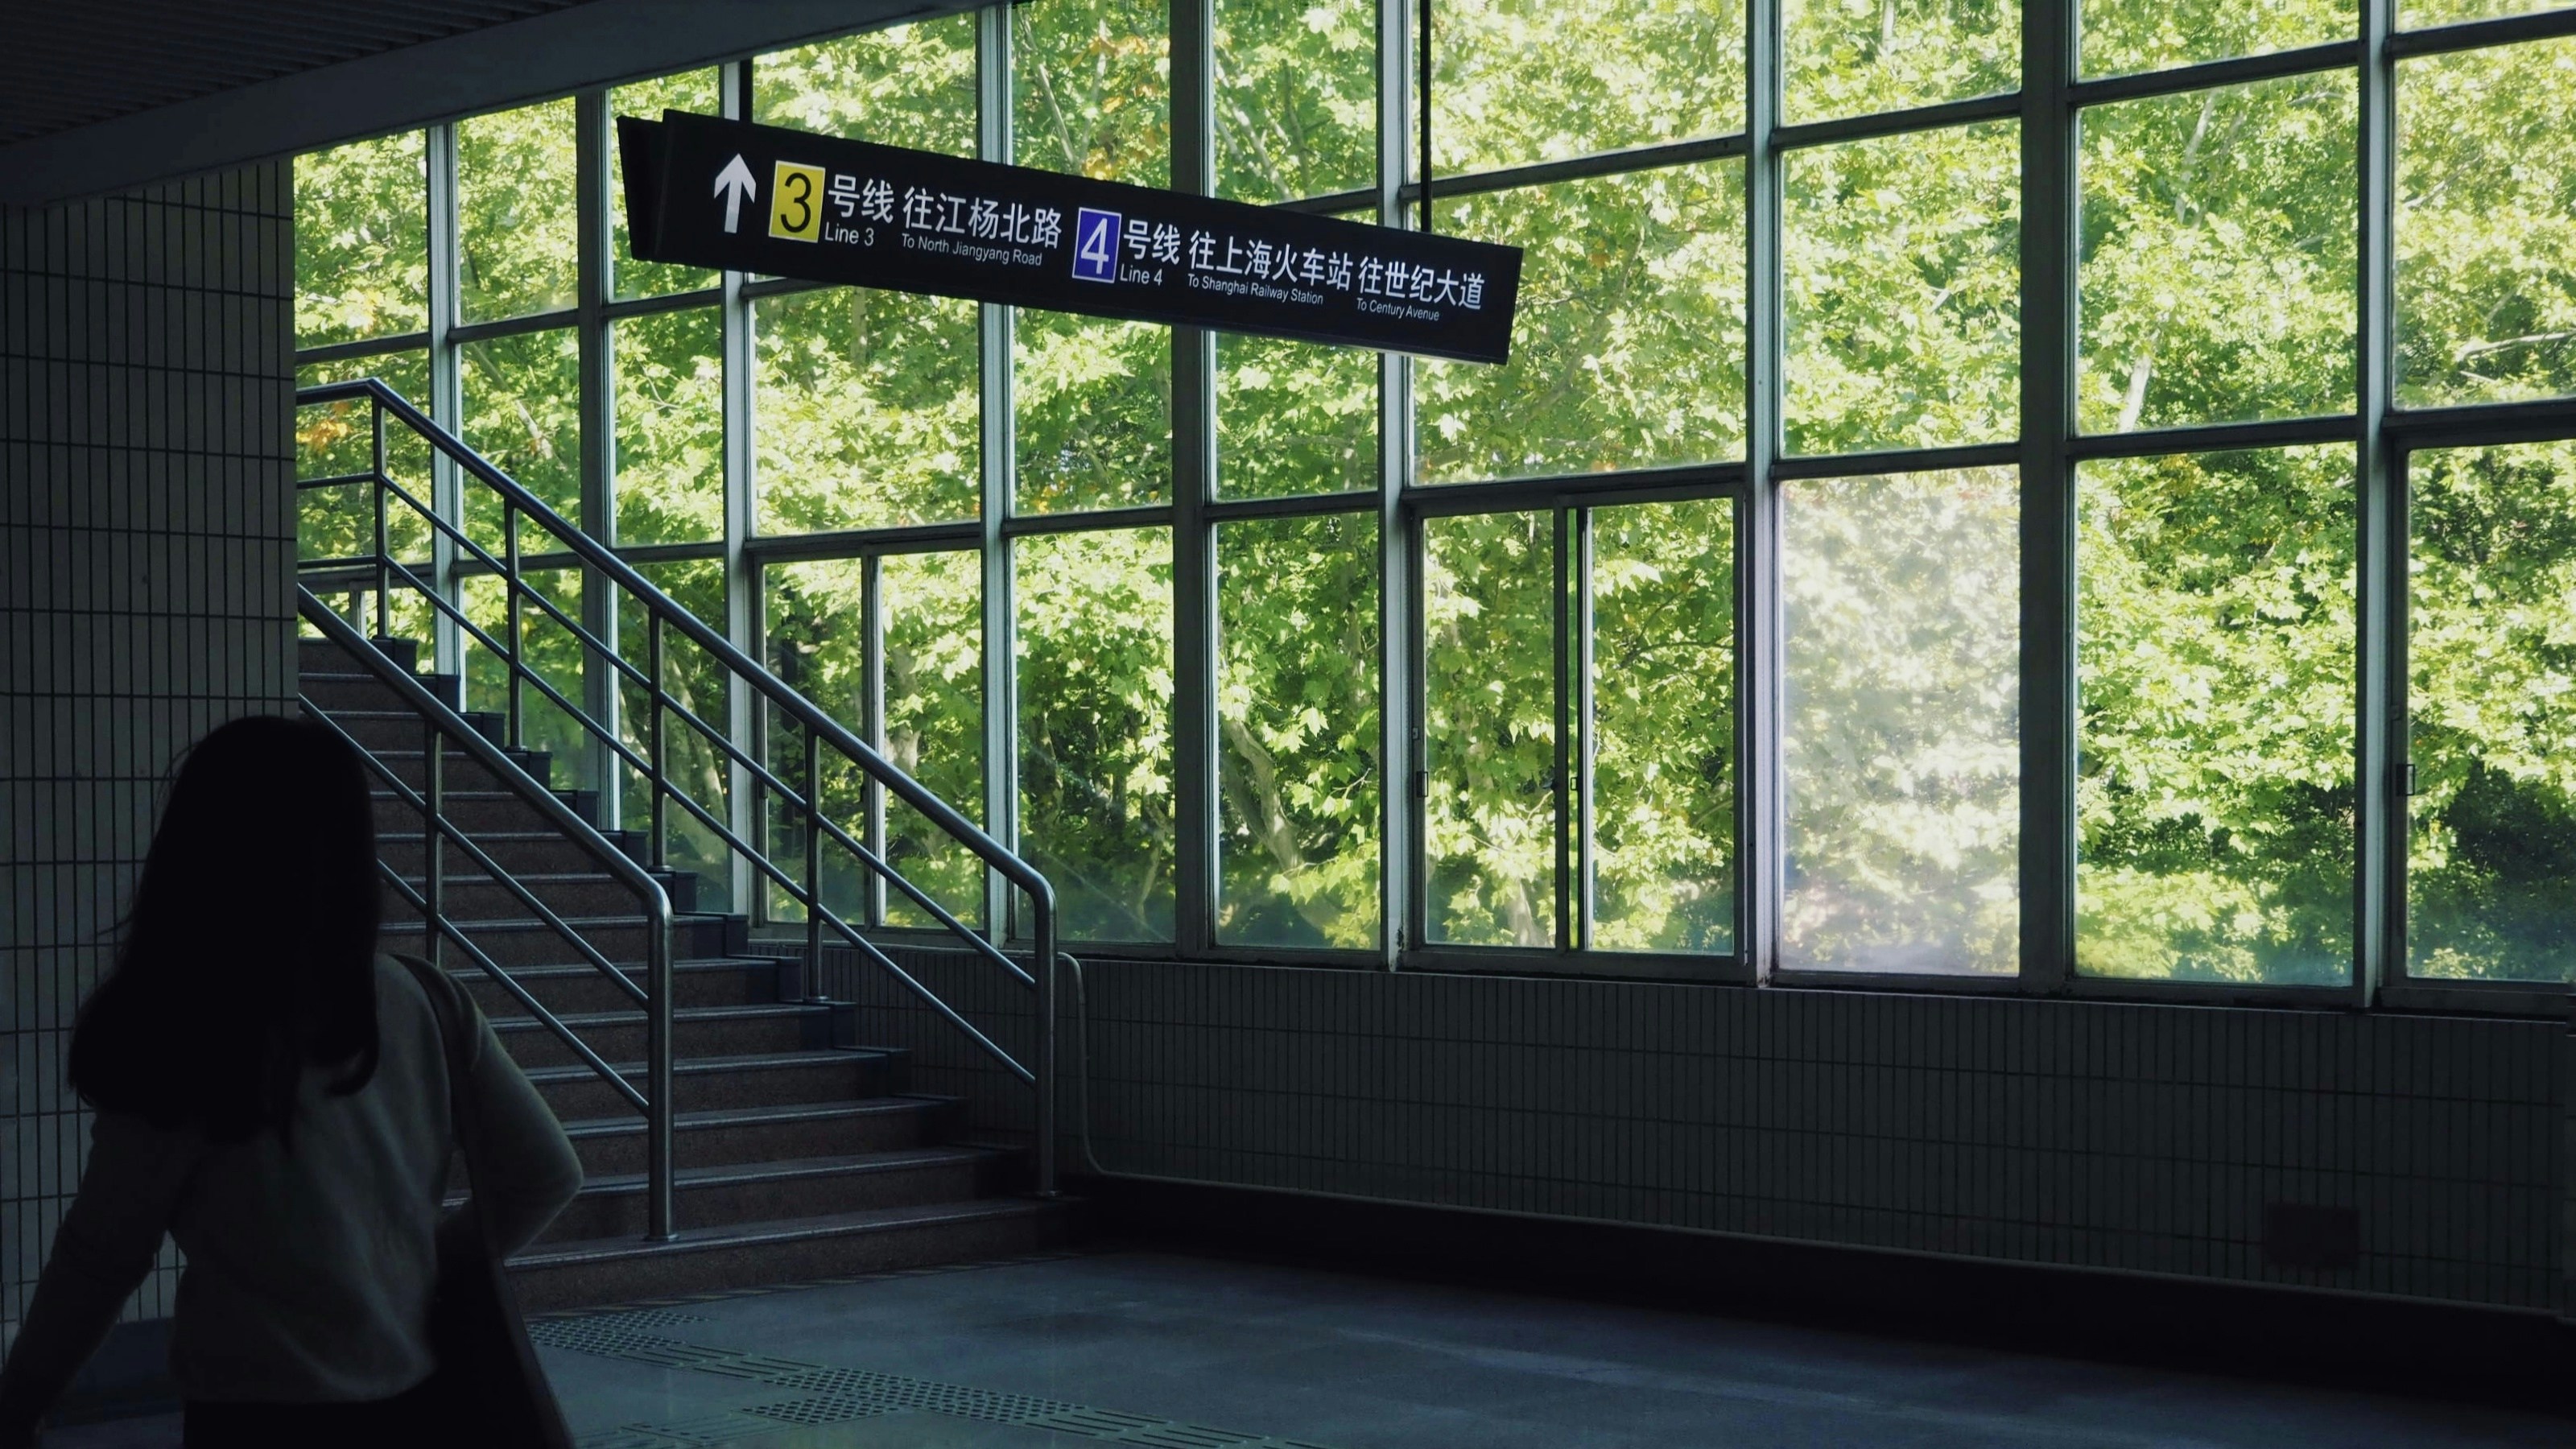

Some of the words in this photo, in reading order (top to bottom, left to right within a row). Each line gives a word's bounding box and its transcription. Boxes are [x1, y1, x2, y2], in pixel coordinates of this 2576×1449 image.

[781, 172, 812, 233] 3
[828, 173, 894, 224] 号线
[902, 186, 1062, 250] 往江杨北路
[824, 221, 860, 245] Line
[864, 227, 875, 246] 3
[902, 233, 915, 249] To
[918, 236, 949, 253] North
[952, 241, 1009, 265] Jiangyang
[1013, 249, 1043, 266] Road
[1080, 217, 1109, 275] 4
[1123, 219, 1181, 265] 号线
[1188, 229, 1354, 291] 往上海火车站
[1358, 255, 1485, 310] 往世纪大道
[1120, 263, 1150, 285] Line
[1153, 268, 1163, 287] 4
[1187, 273, 1199, 288] To
[1201, 275, 1249, 295] Shanghai
[1250, 282, 1289, 303] Railway
[1290, 288, 1324, 305] Station
[1356, 297, 1368, 312] To
[1369, 299, 1405, 320] Century
[1405, 303, 1440, 322] Avenue
